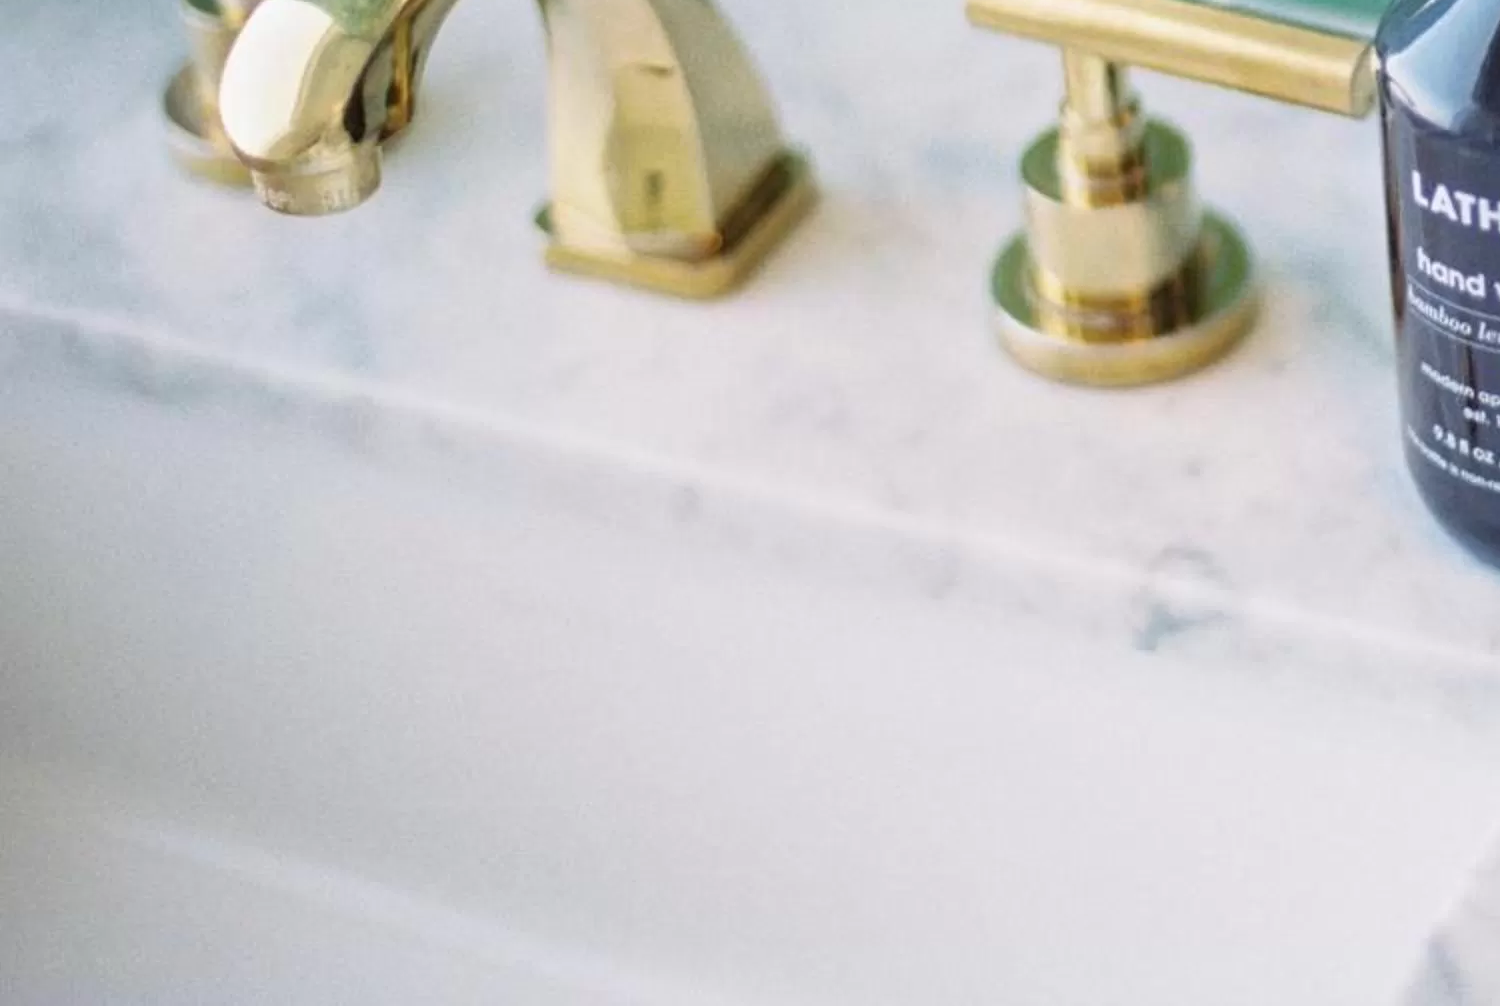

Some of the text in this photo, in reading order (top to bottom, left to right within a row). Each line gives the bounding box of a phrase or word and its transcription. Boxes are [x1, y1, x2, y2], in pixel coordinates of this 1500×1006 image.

[1416, 245, 1486, 299] hand
[1407, 283, 1472, 336] bamboo
[1420, 361, 1475, 399] modern
[1472, 446, 1495, 465] oz
